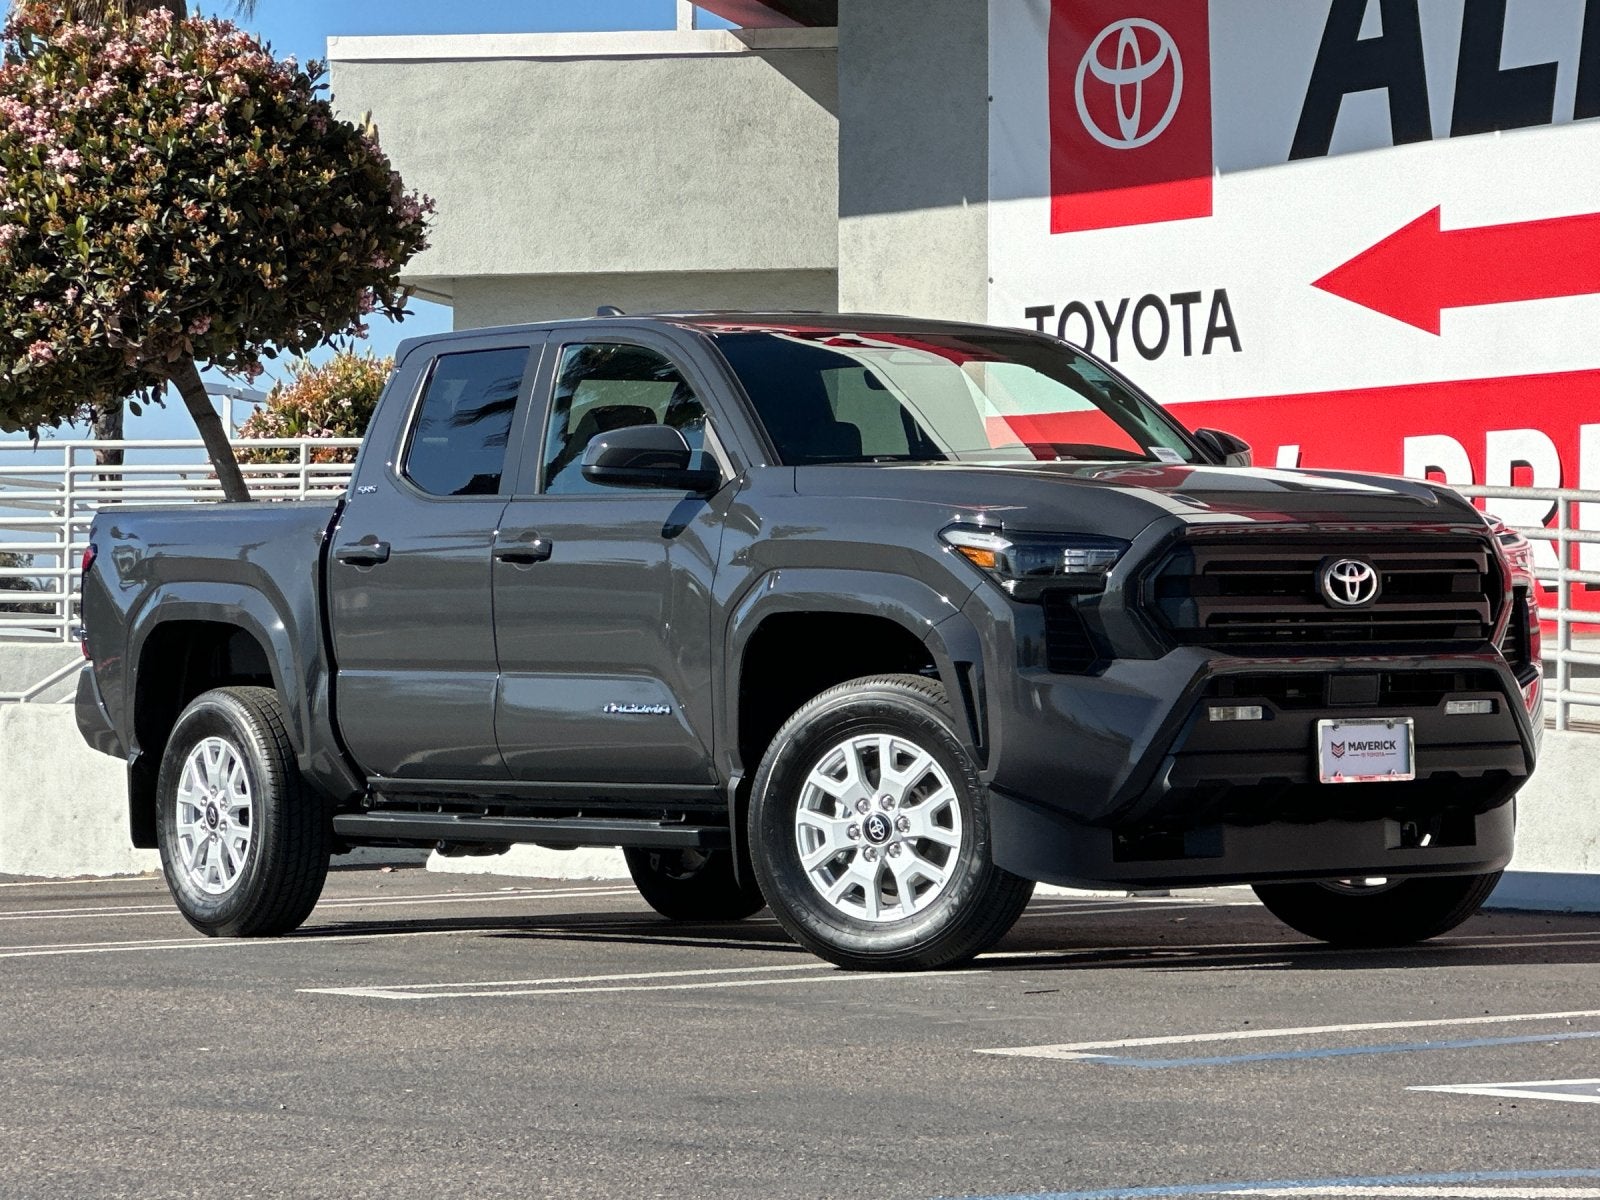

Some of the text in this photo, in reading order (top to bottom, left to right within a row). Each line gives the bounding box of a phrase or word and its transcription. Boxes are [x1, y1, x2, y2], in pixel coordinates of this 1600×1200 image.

[1287, 0, 1600, 161] AL
[1025, 288, 1243, 362] TOYOTA
[1348, 740, 1396, 751] MAVERICK
